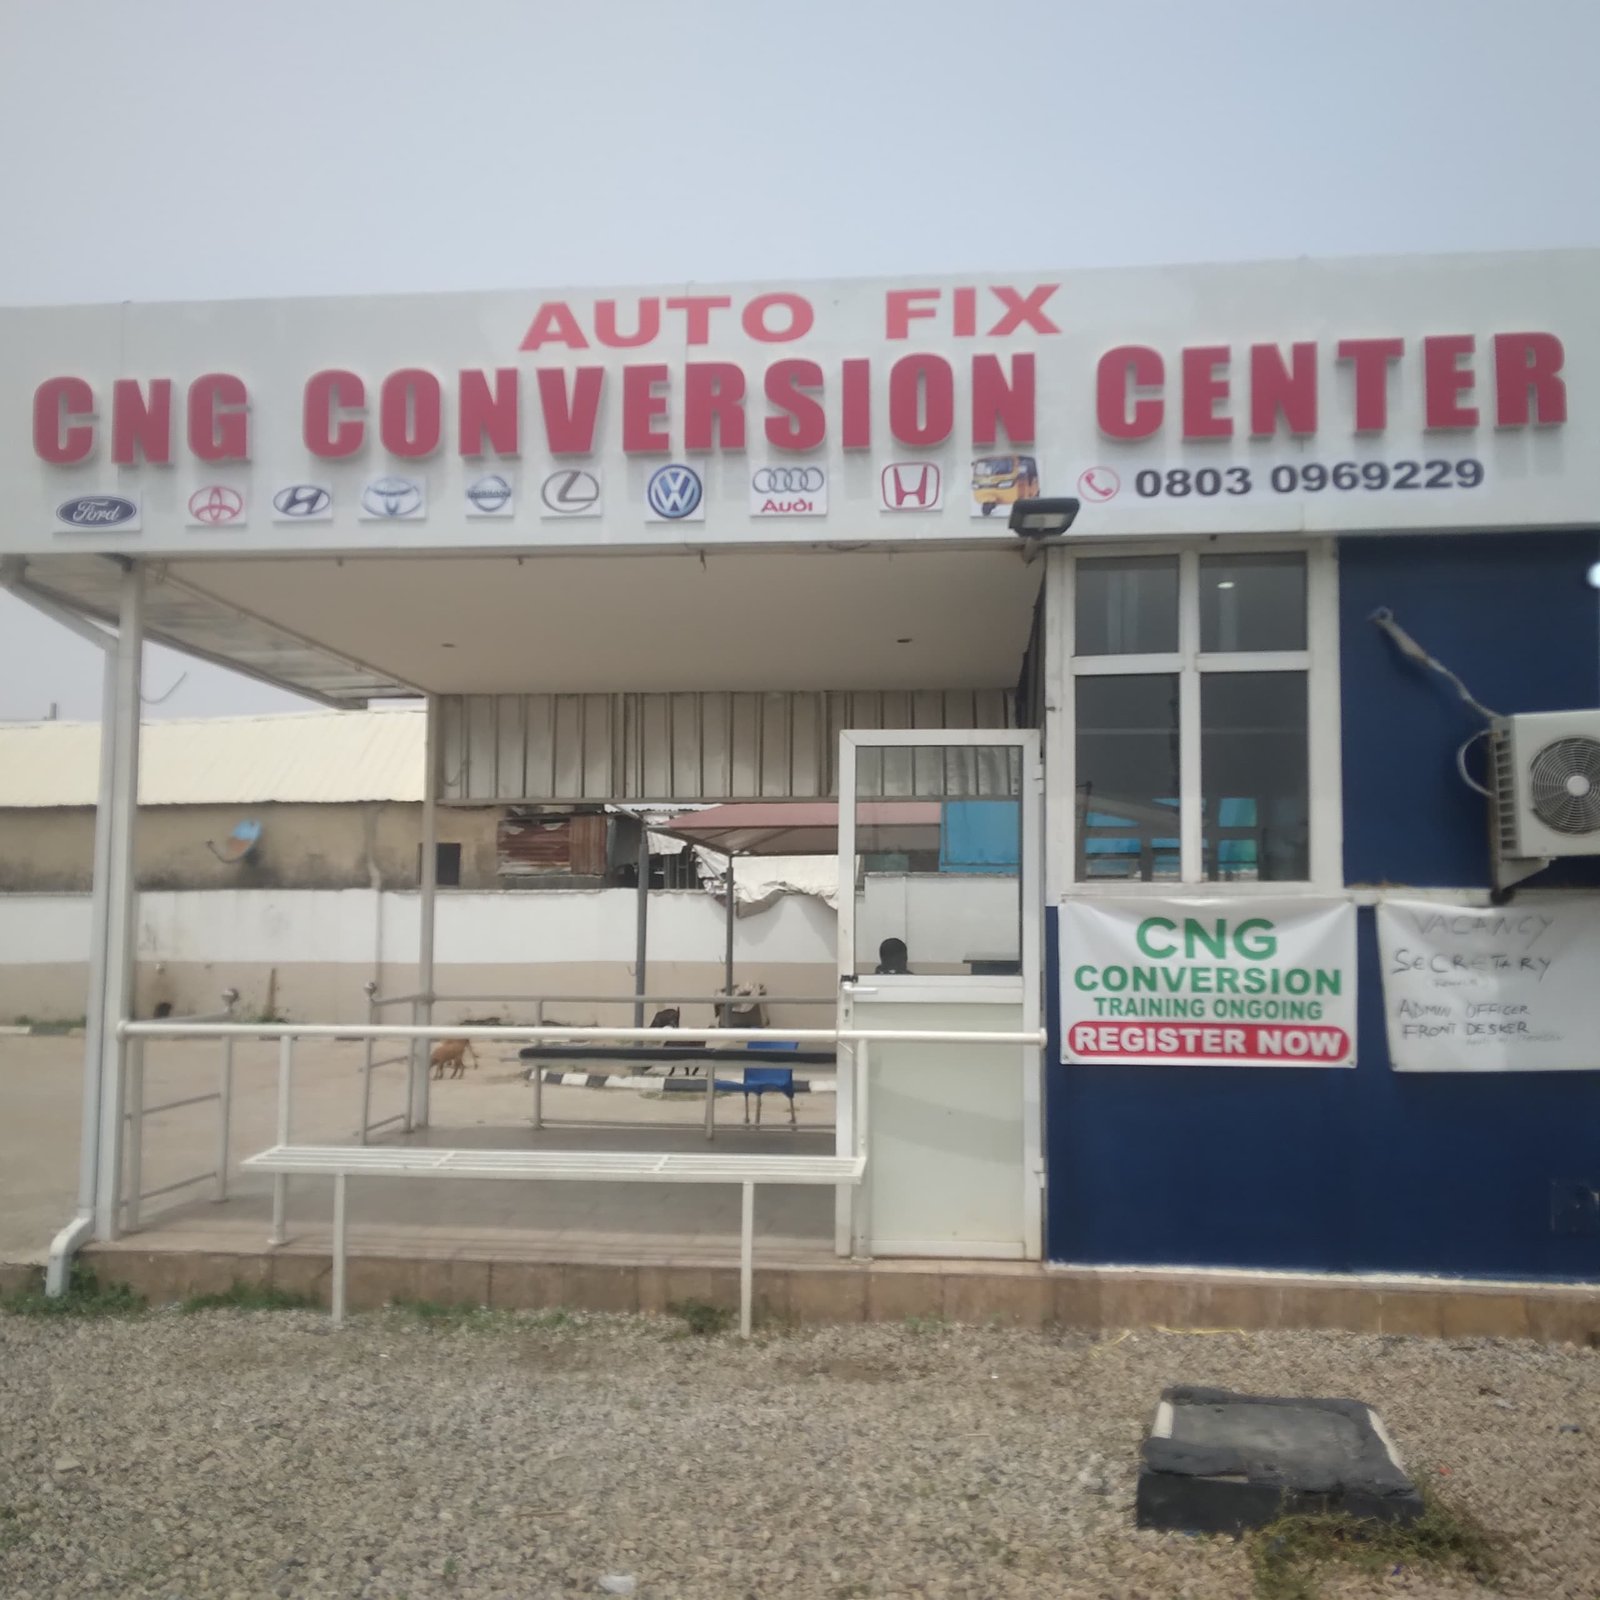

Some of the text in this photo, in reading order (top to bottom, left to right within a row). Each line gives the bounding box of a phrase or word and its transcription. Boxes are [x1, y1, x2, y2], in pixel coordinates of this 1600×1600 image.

[519, 283, 1062, 352] AUTO FIX
[33, 332, 1568, 465] CNG CONVERSION CENTER
[1135, 458, 1485, 498] 0803 0969229
[73, 500, 120, 521] Ford
[1136, 916, 1278, 961] CNG
[1411, 914, 1553, 950] VACANCY
[1074, 965, 1342, 995] CONVERSION
[1094, 997, 1323, 1020] TRAINING ONGOING
[1400, 1000, 1530, 1019] ADMIN OFFICER
[1074, 1026, 1343, 1056] REGISTER NOW
[1403, 1023, 1457, 1040] FRONT
